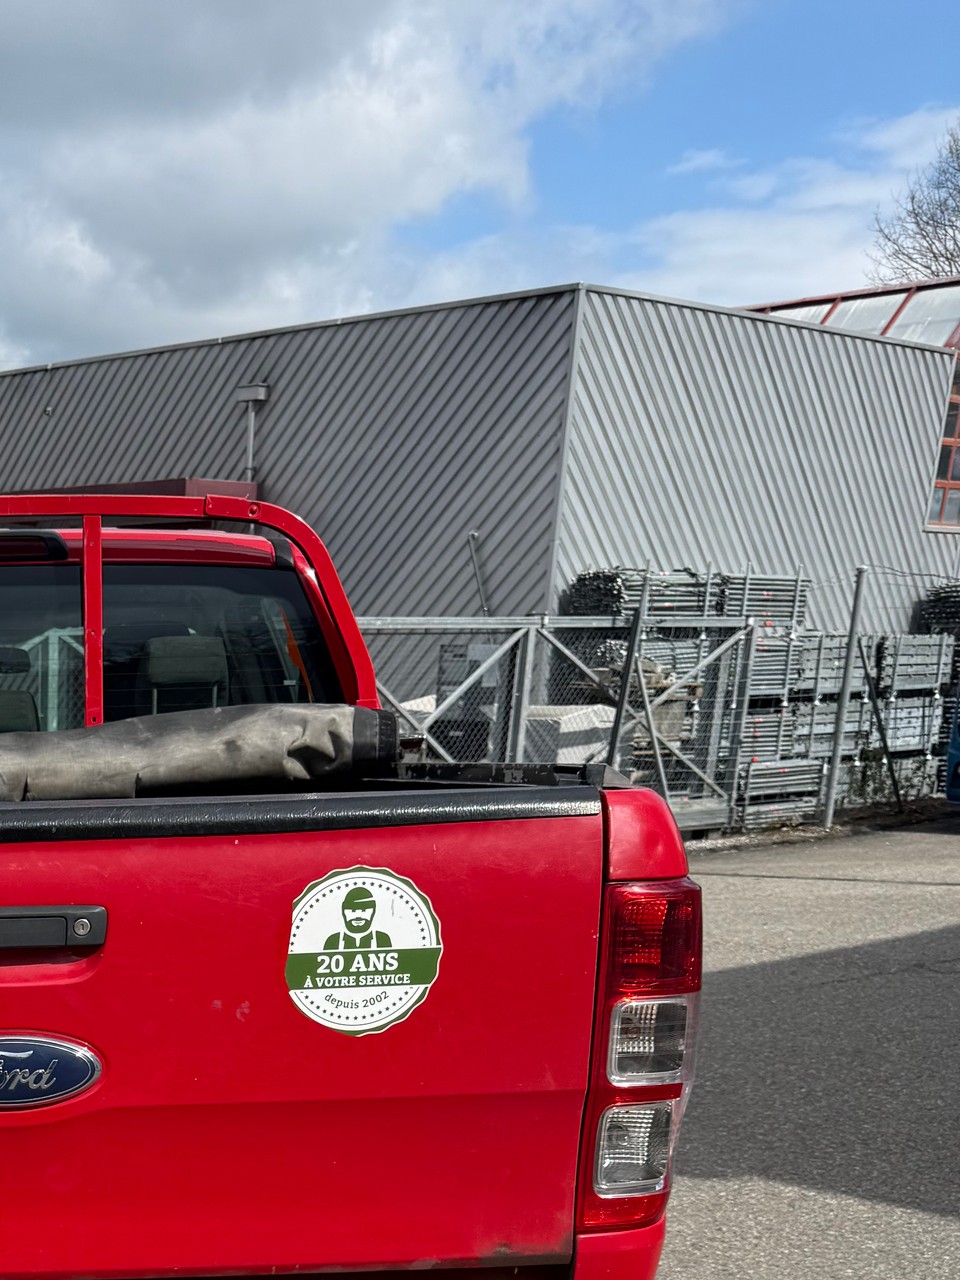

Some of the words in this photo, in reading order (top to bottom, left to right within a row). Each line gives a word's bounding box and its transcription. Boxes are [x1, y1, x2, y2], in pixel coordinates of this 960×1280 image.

[316, 954, 345, 974] 20
[349, 952, 399, 973] ANS
[303, 975, 313, 988] À
[315, 976, 357, 988] VOTRE
[358, 974, 411, 985] SERVICE
[324, 993, 360, 1009] depuis
[362, 991, 389, 1008] 2002
